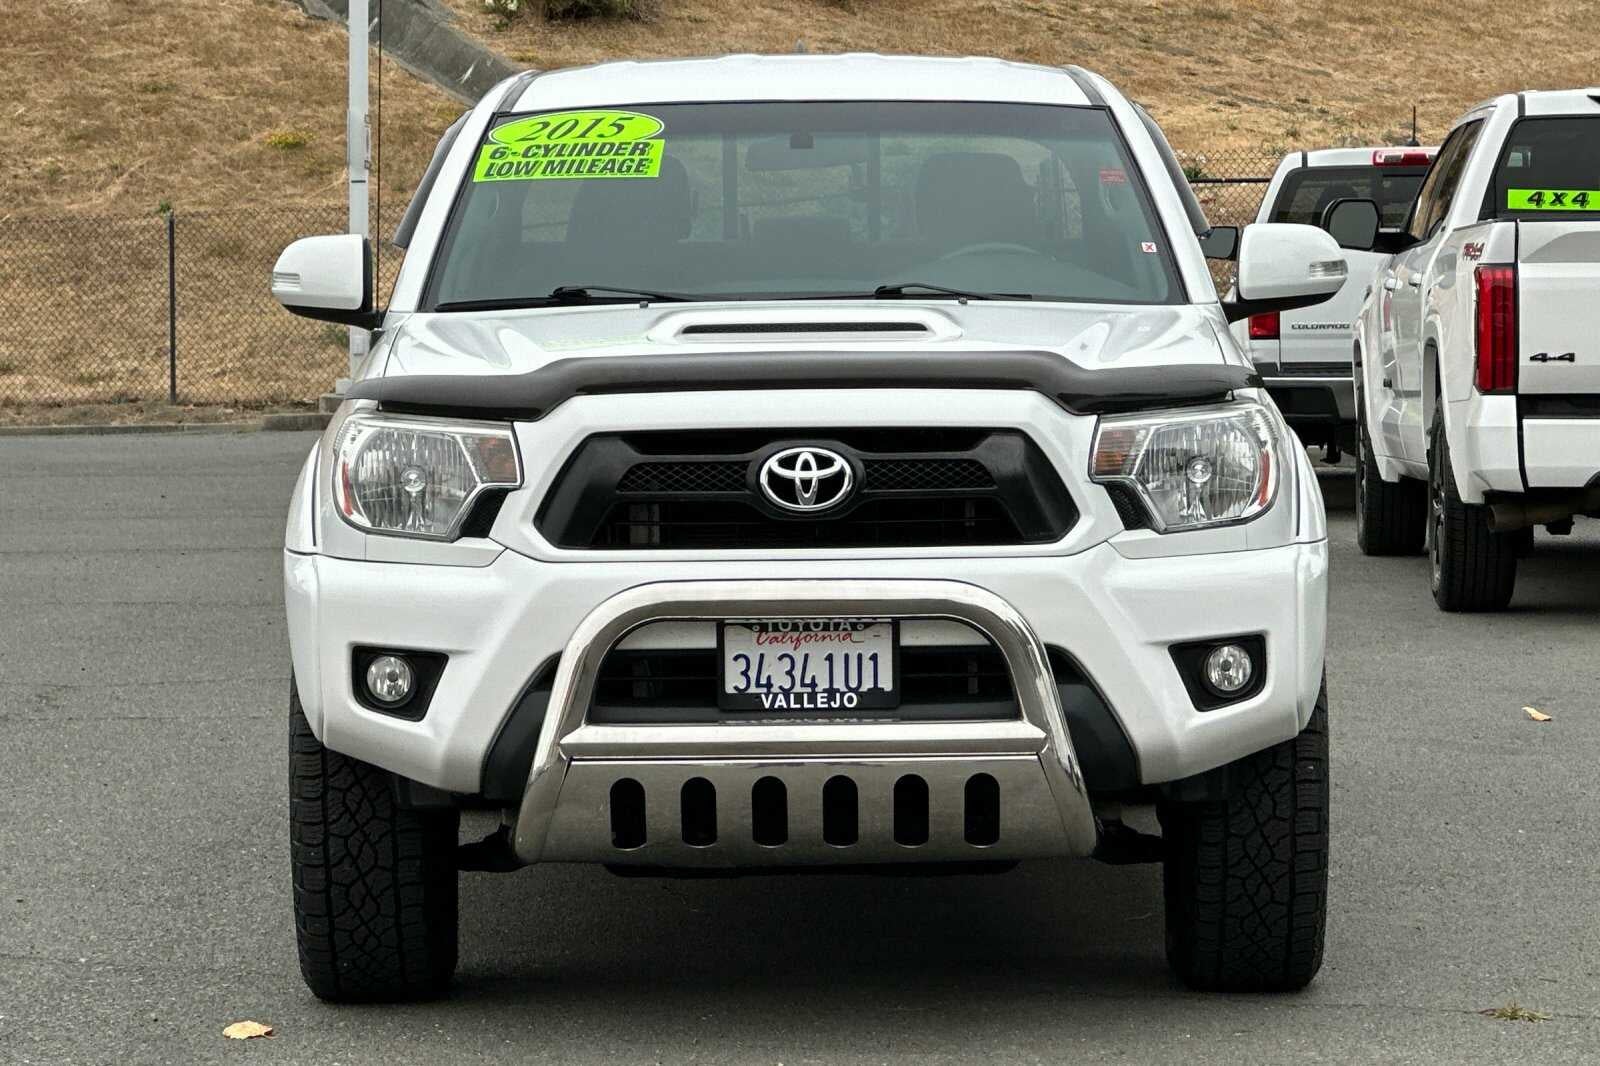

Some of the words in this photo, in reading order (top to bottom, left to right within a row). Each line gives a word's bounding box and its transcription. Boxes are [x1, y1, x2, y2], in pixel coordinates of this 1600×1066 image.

[515, 116, 634, 142] 2015
[489, 142, 651, 160] 6-CYLINDER
[484, 160, 543, 178] LOW
[541, 158, 651, 175] MILEAGE
[756, 631, 864, 650] California
[732, 653, 884, 693] 34341U1
[761, 692, 858, 709] VALLEJO
